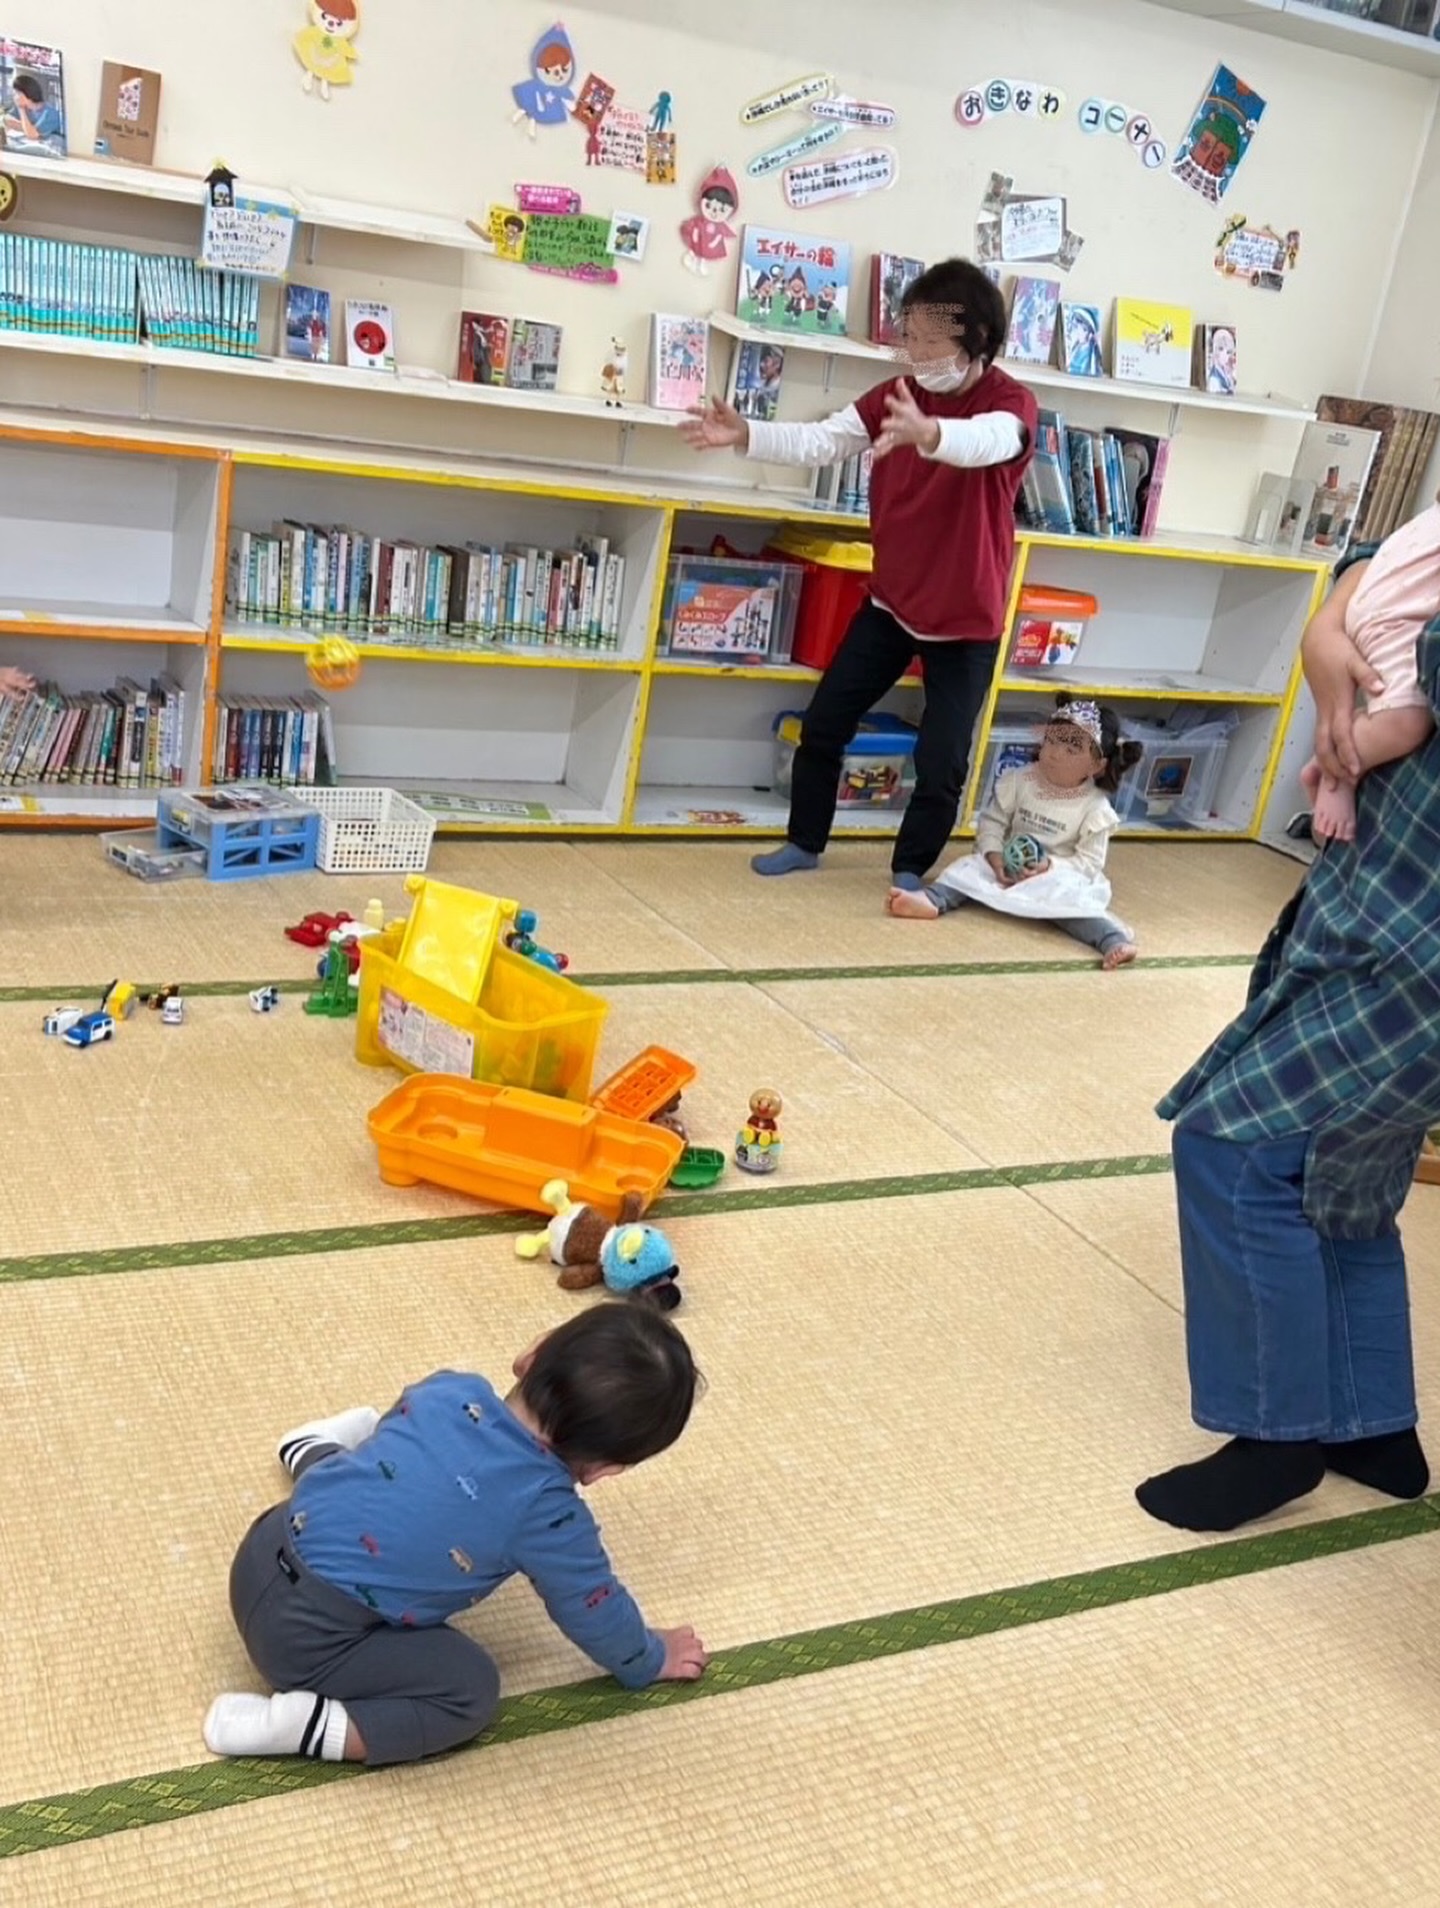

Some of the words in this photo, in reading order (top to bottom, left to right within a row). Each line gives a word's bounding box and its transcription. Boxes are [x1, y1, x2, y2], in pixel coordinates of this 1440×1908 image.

[964, 86, 1059, 118] おきなわ
[1085, 106, 1161, 162] コーナー
[757, 237, 835, 268] エイサーの輪
